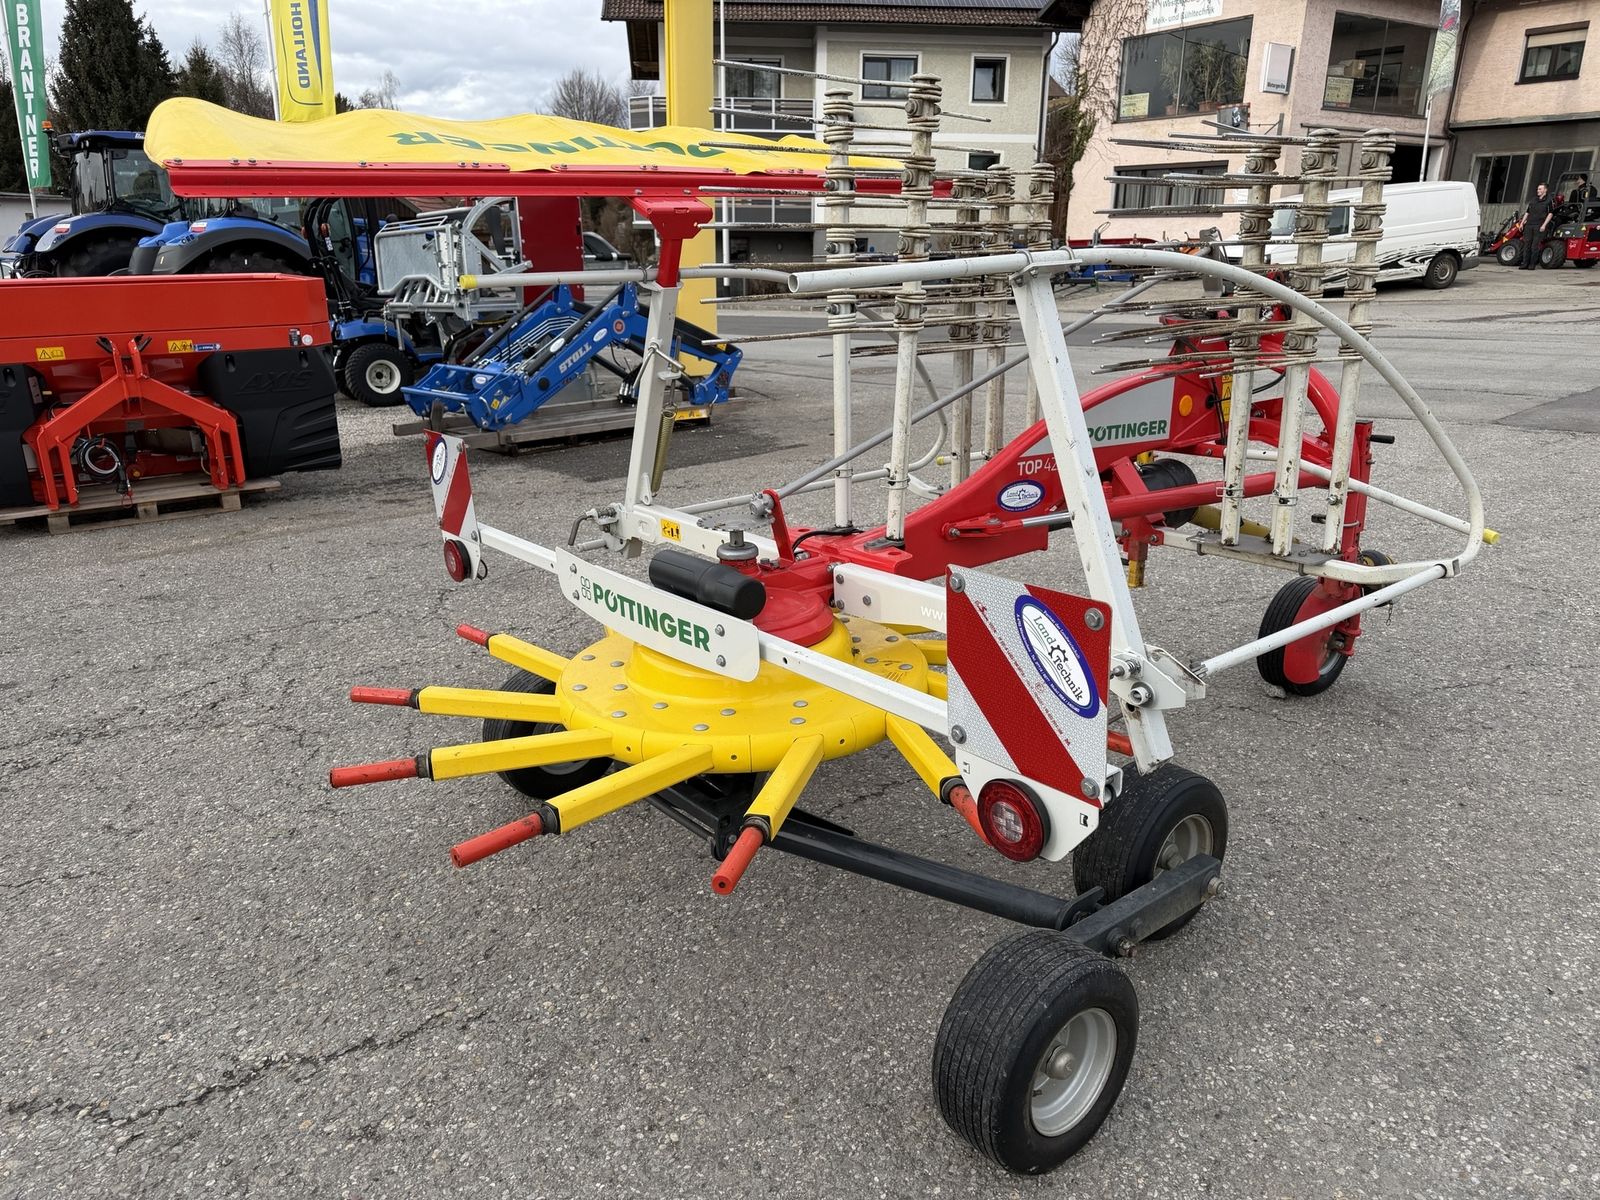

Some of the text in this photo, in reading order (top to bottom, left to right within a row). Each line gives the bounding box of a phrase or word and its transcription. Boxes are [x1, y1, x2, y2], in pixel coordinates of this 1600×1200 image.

[15, 3, 39, 178] BRANTNER
[558, 342, 592, 374] STOLL
[1017, 458, 1043, 476] TOP
[592, 582, 710, 653] PÖTTINGER
[1033, 615, 1057, 646] Land
[1052, 655, 1083, 701] Technik
